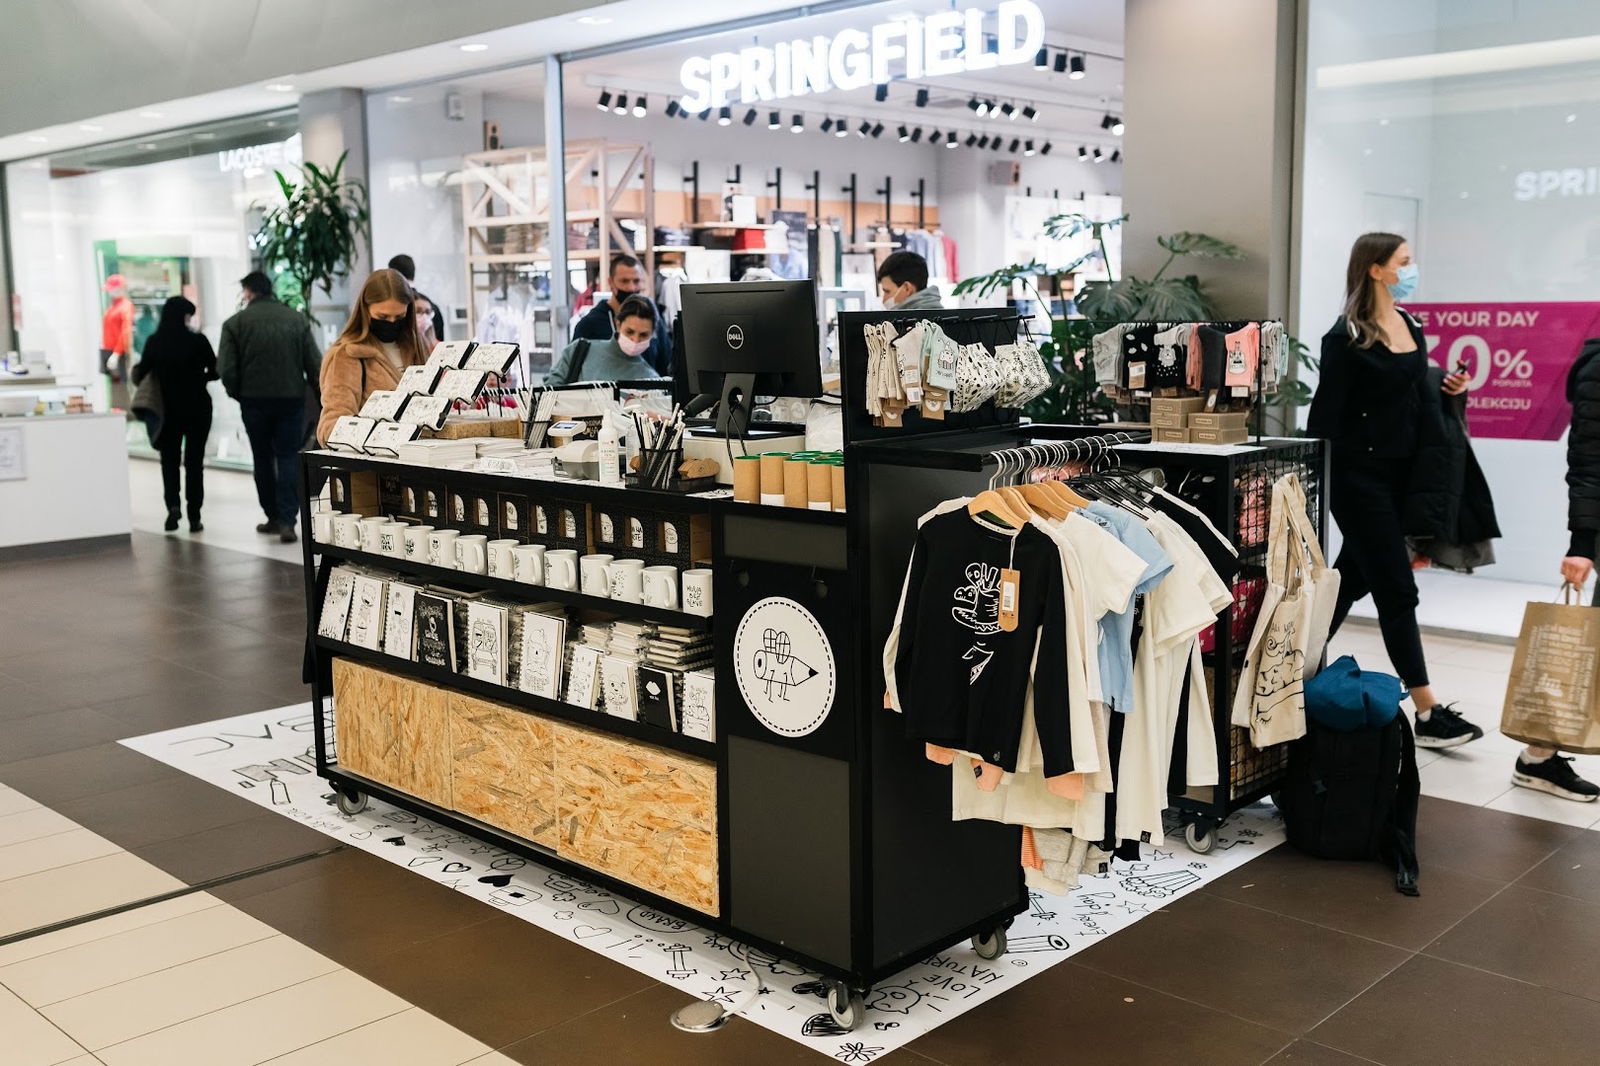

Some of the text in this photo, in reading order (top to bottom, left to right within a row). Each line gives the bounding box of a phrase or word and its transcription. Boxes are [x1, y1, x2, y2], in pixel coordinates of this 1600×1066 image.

[680, 0, 1045, 113] SPRINGFIELD
[1514, 167, 1600, 200] SPRI
[1435, 311, 1491, 327] YOUR
[1496, 311, 1539, 327] DAY
[728, 333, 742, 341] DELL
[922, 973, 981, 999] LOVE
